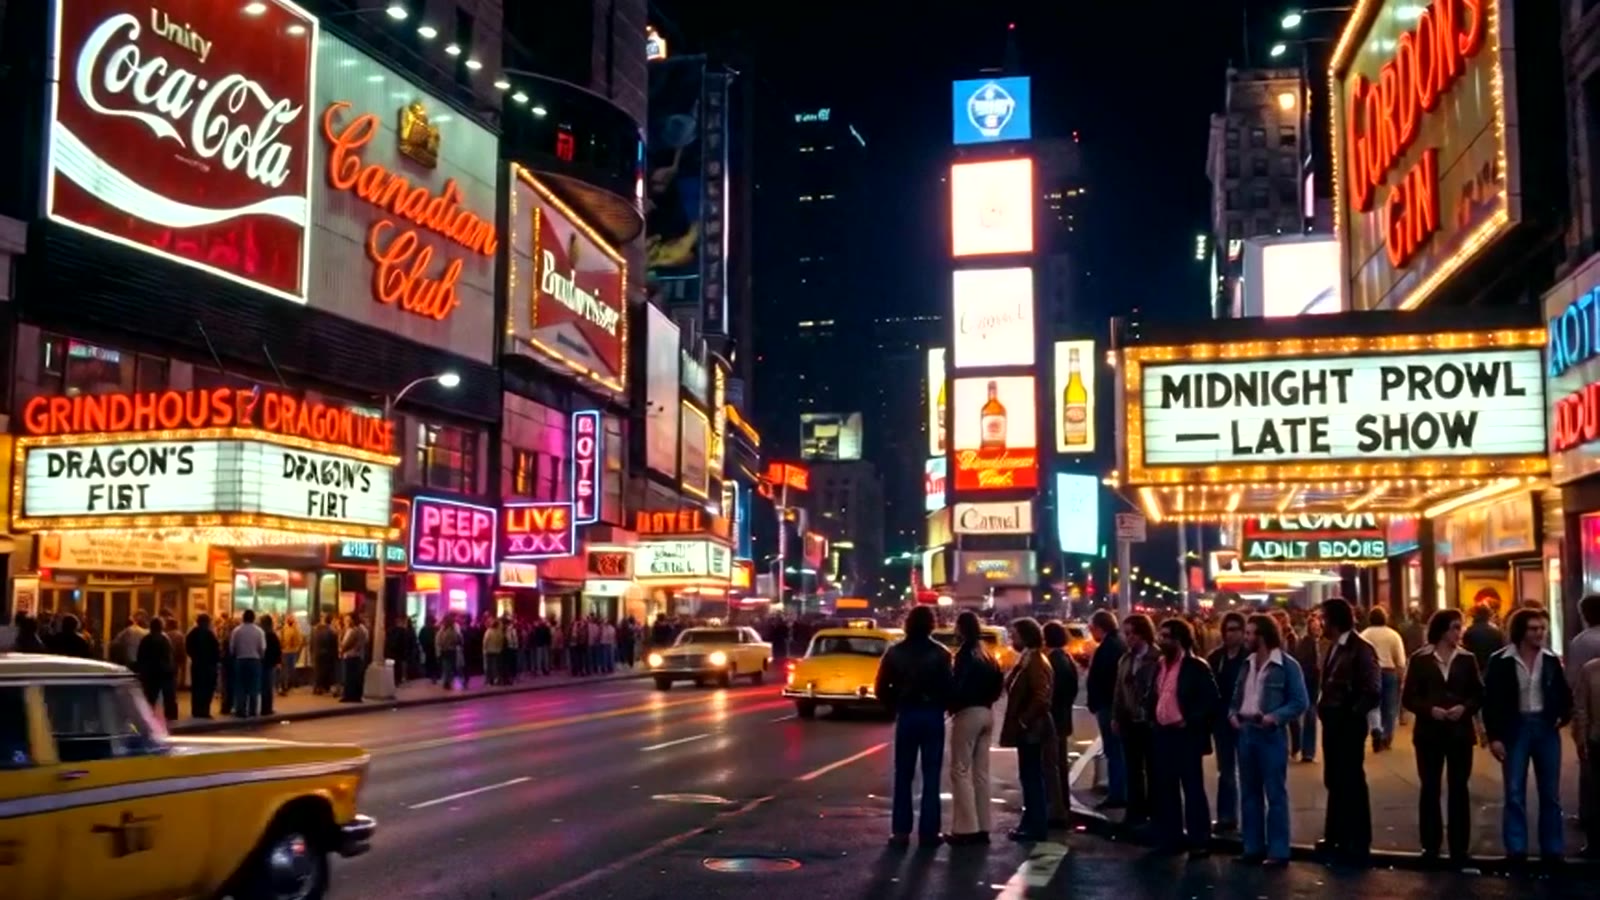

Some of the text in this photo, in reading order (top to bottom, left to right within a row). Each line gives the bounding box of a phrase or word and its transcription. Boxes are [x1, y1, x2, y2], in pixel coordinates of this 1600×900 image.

[324, 101, 498, 256] Canadian
[1386, 148, 1440, 268] GIN
[371, 219, 461, 320] Club
[1161, 361, 1526, 409] MIDNIGHT PROWL
[1231, 416, 1331, 455] LATE
[1355, 410, 1480, 452] SHOW
[1555, 381, 1600, 451] ADU
[47, 445, 195, 479] DRAGON'S
[422, 506, 490, 537] PEEP
[507, 508, 566, 532] LIVE
